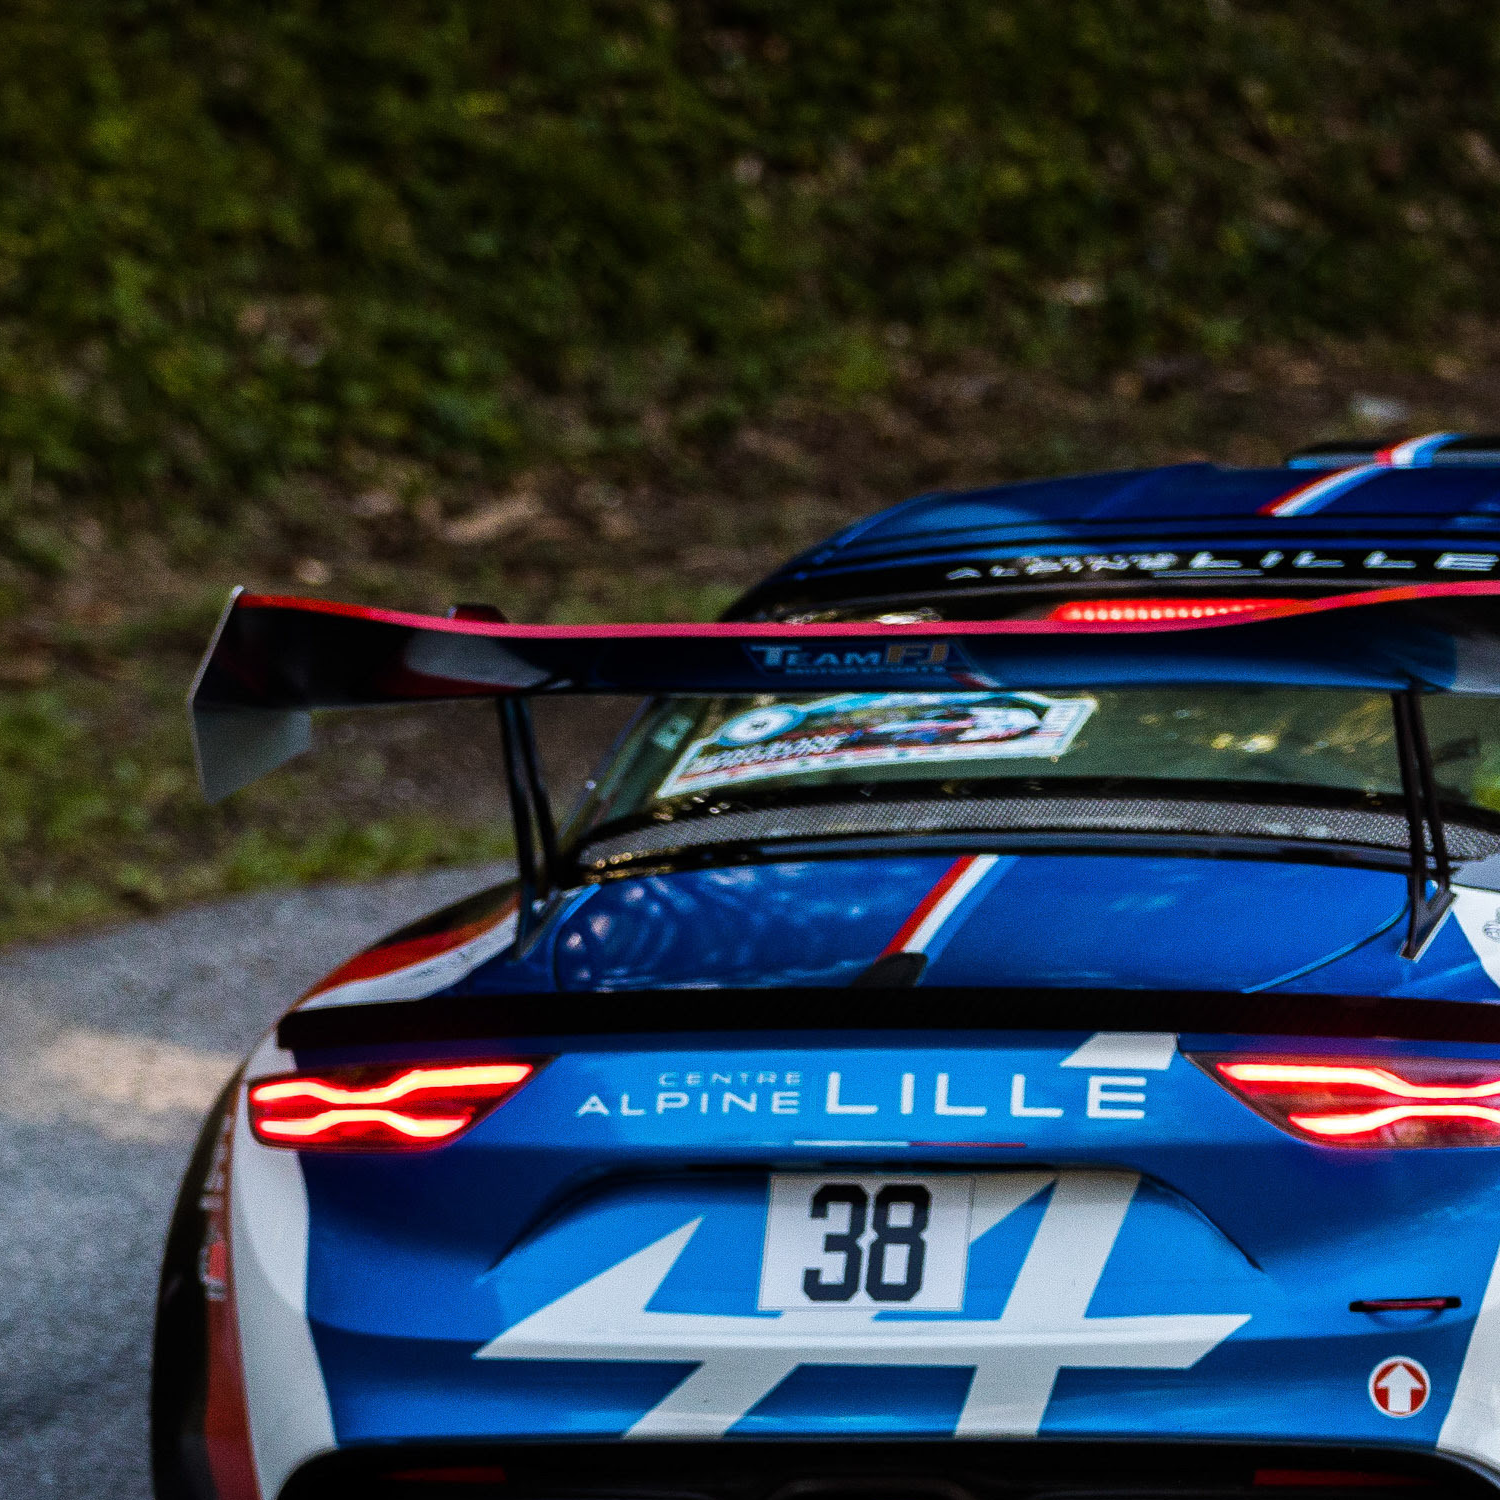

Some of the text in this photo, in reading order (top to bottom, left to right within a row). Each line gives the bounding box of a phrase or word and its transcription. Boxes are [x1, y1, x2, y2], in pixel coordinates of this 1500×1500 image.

[577, 1071, 1147, 1119] ALPINE LILLE
[657, 1071, 800, 1087] CENTRE
[802, 1184, 933, 1303] 38
